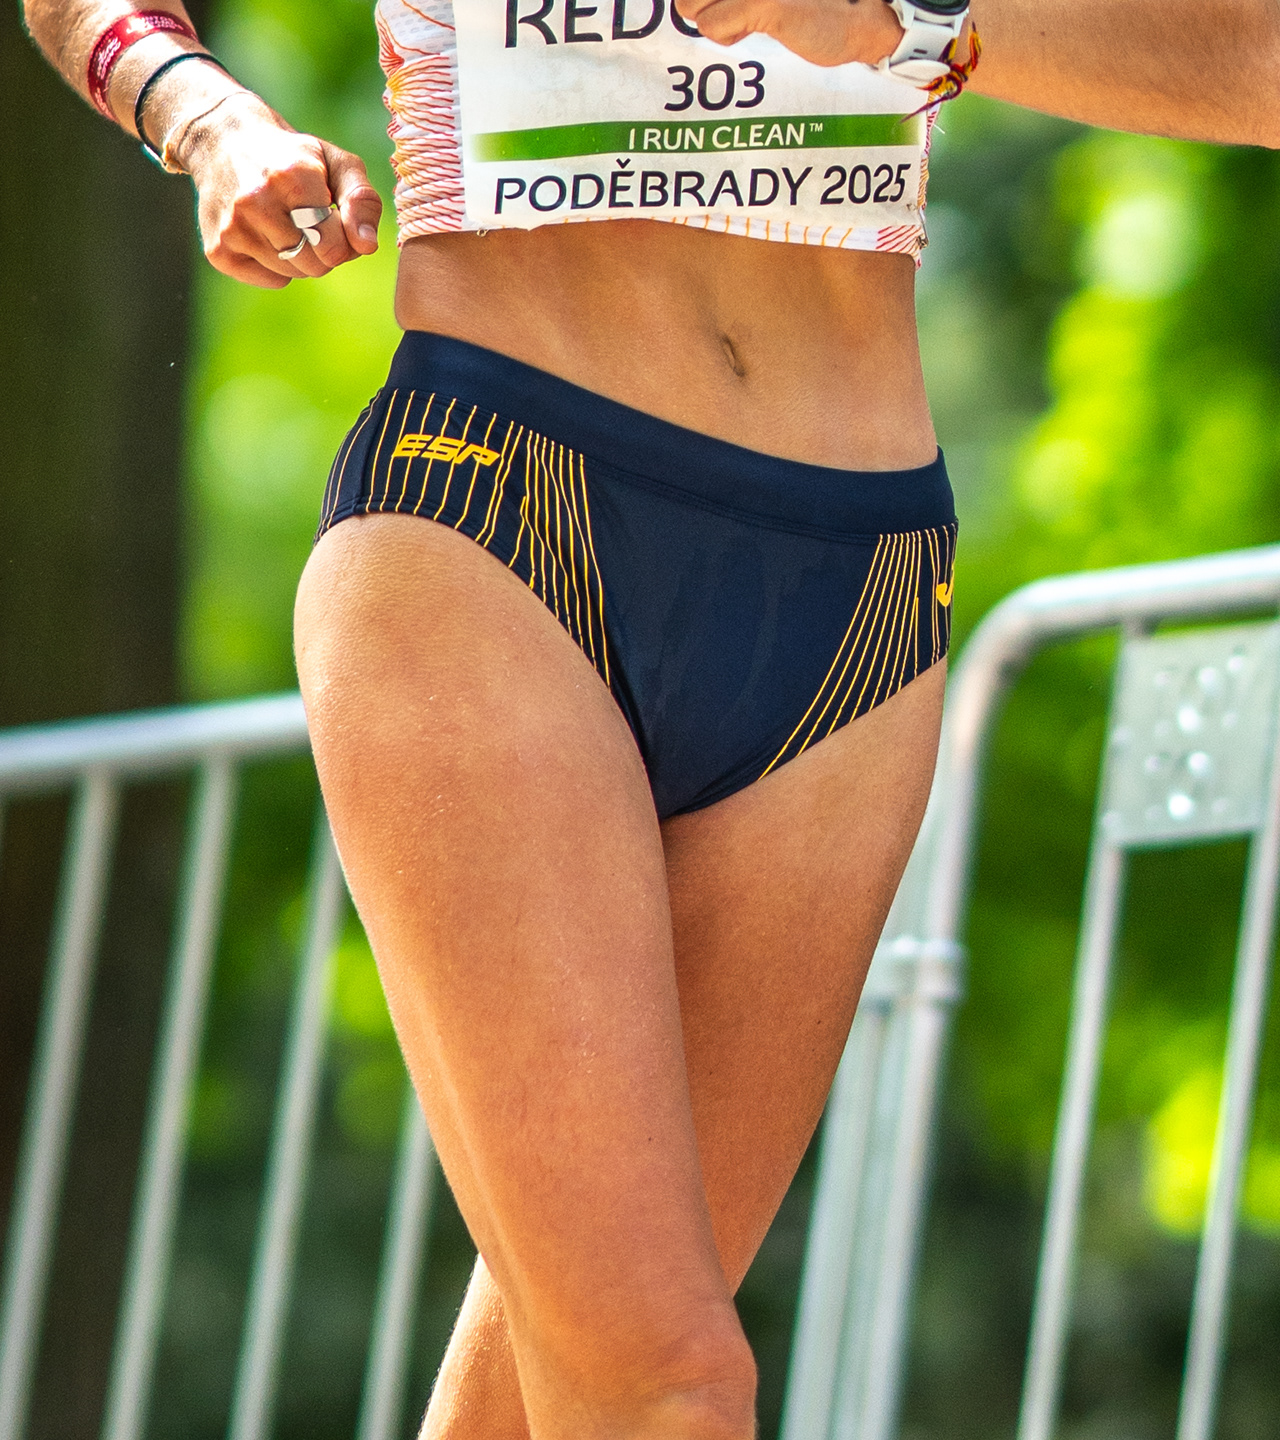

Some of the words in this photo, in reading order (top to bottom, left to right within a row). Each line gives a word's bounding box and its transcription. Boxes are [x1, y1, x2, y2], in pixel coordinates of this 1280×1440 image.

[664, 60, 766, 112] 303
[628, 127, 635, 150] I
[642, 126, 704, 151] RUN
[494, 158, 814, 215] PODĚBRADY
[819, 162, 912, 206] 2025
